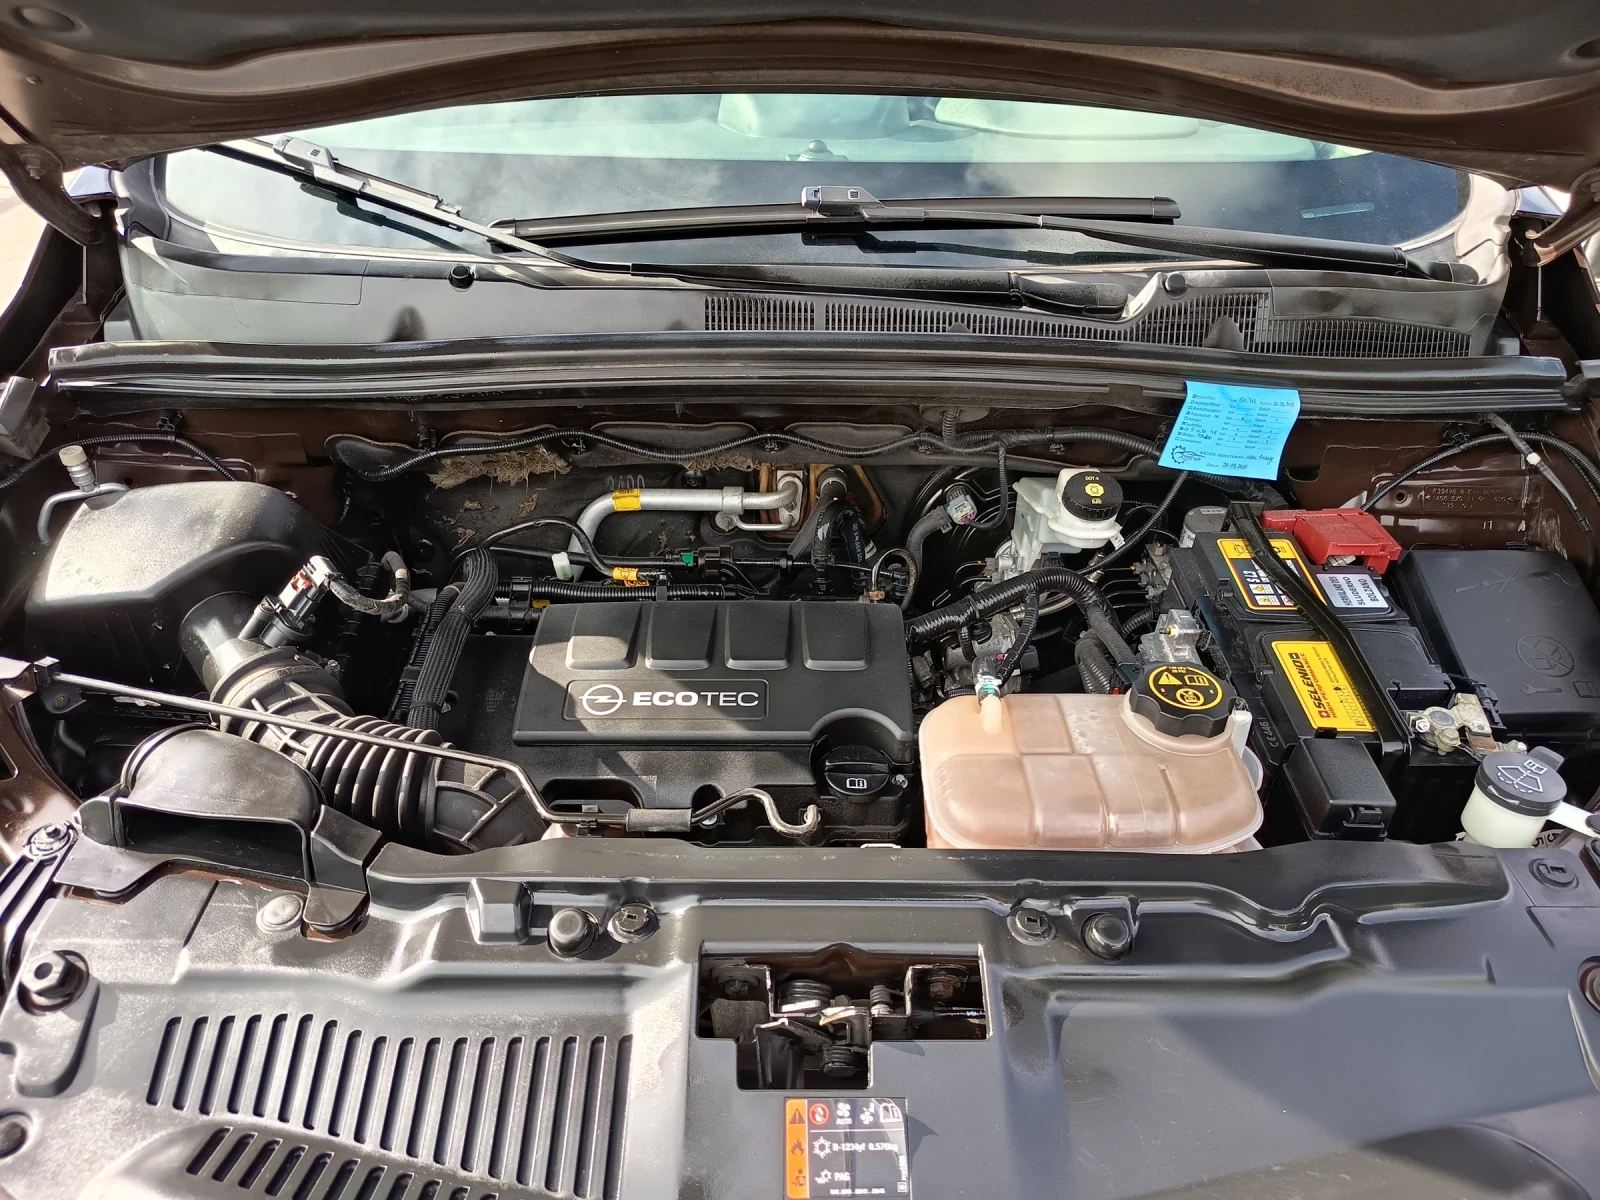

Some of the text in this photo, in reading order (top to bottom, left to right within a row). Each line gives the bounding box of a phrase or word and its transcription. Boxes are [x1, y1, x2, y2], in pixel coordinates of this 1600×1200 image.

[1342, 576, 1366, 606] SLUDERNO
[1358, 578, 1380, 602] BOLZANO
[1300, 652, 1338, 719] HIGH PERFORMANCE
[632, 691, 760, 707] ECOTEC
[834, 1172, 851, 1181] PAG
